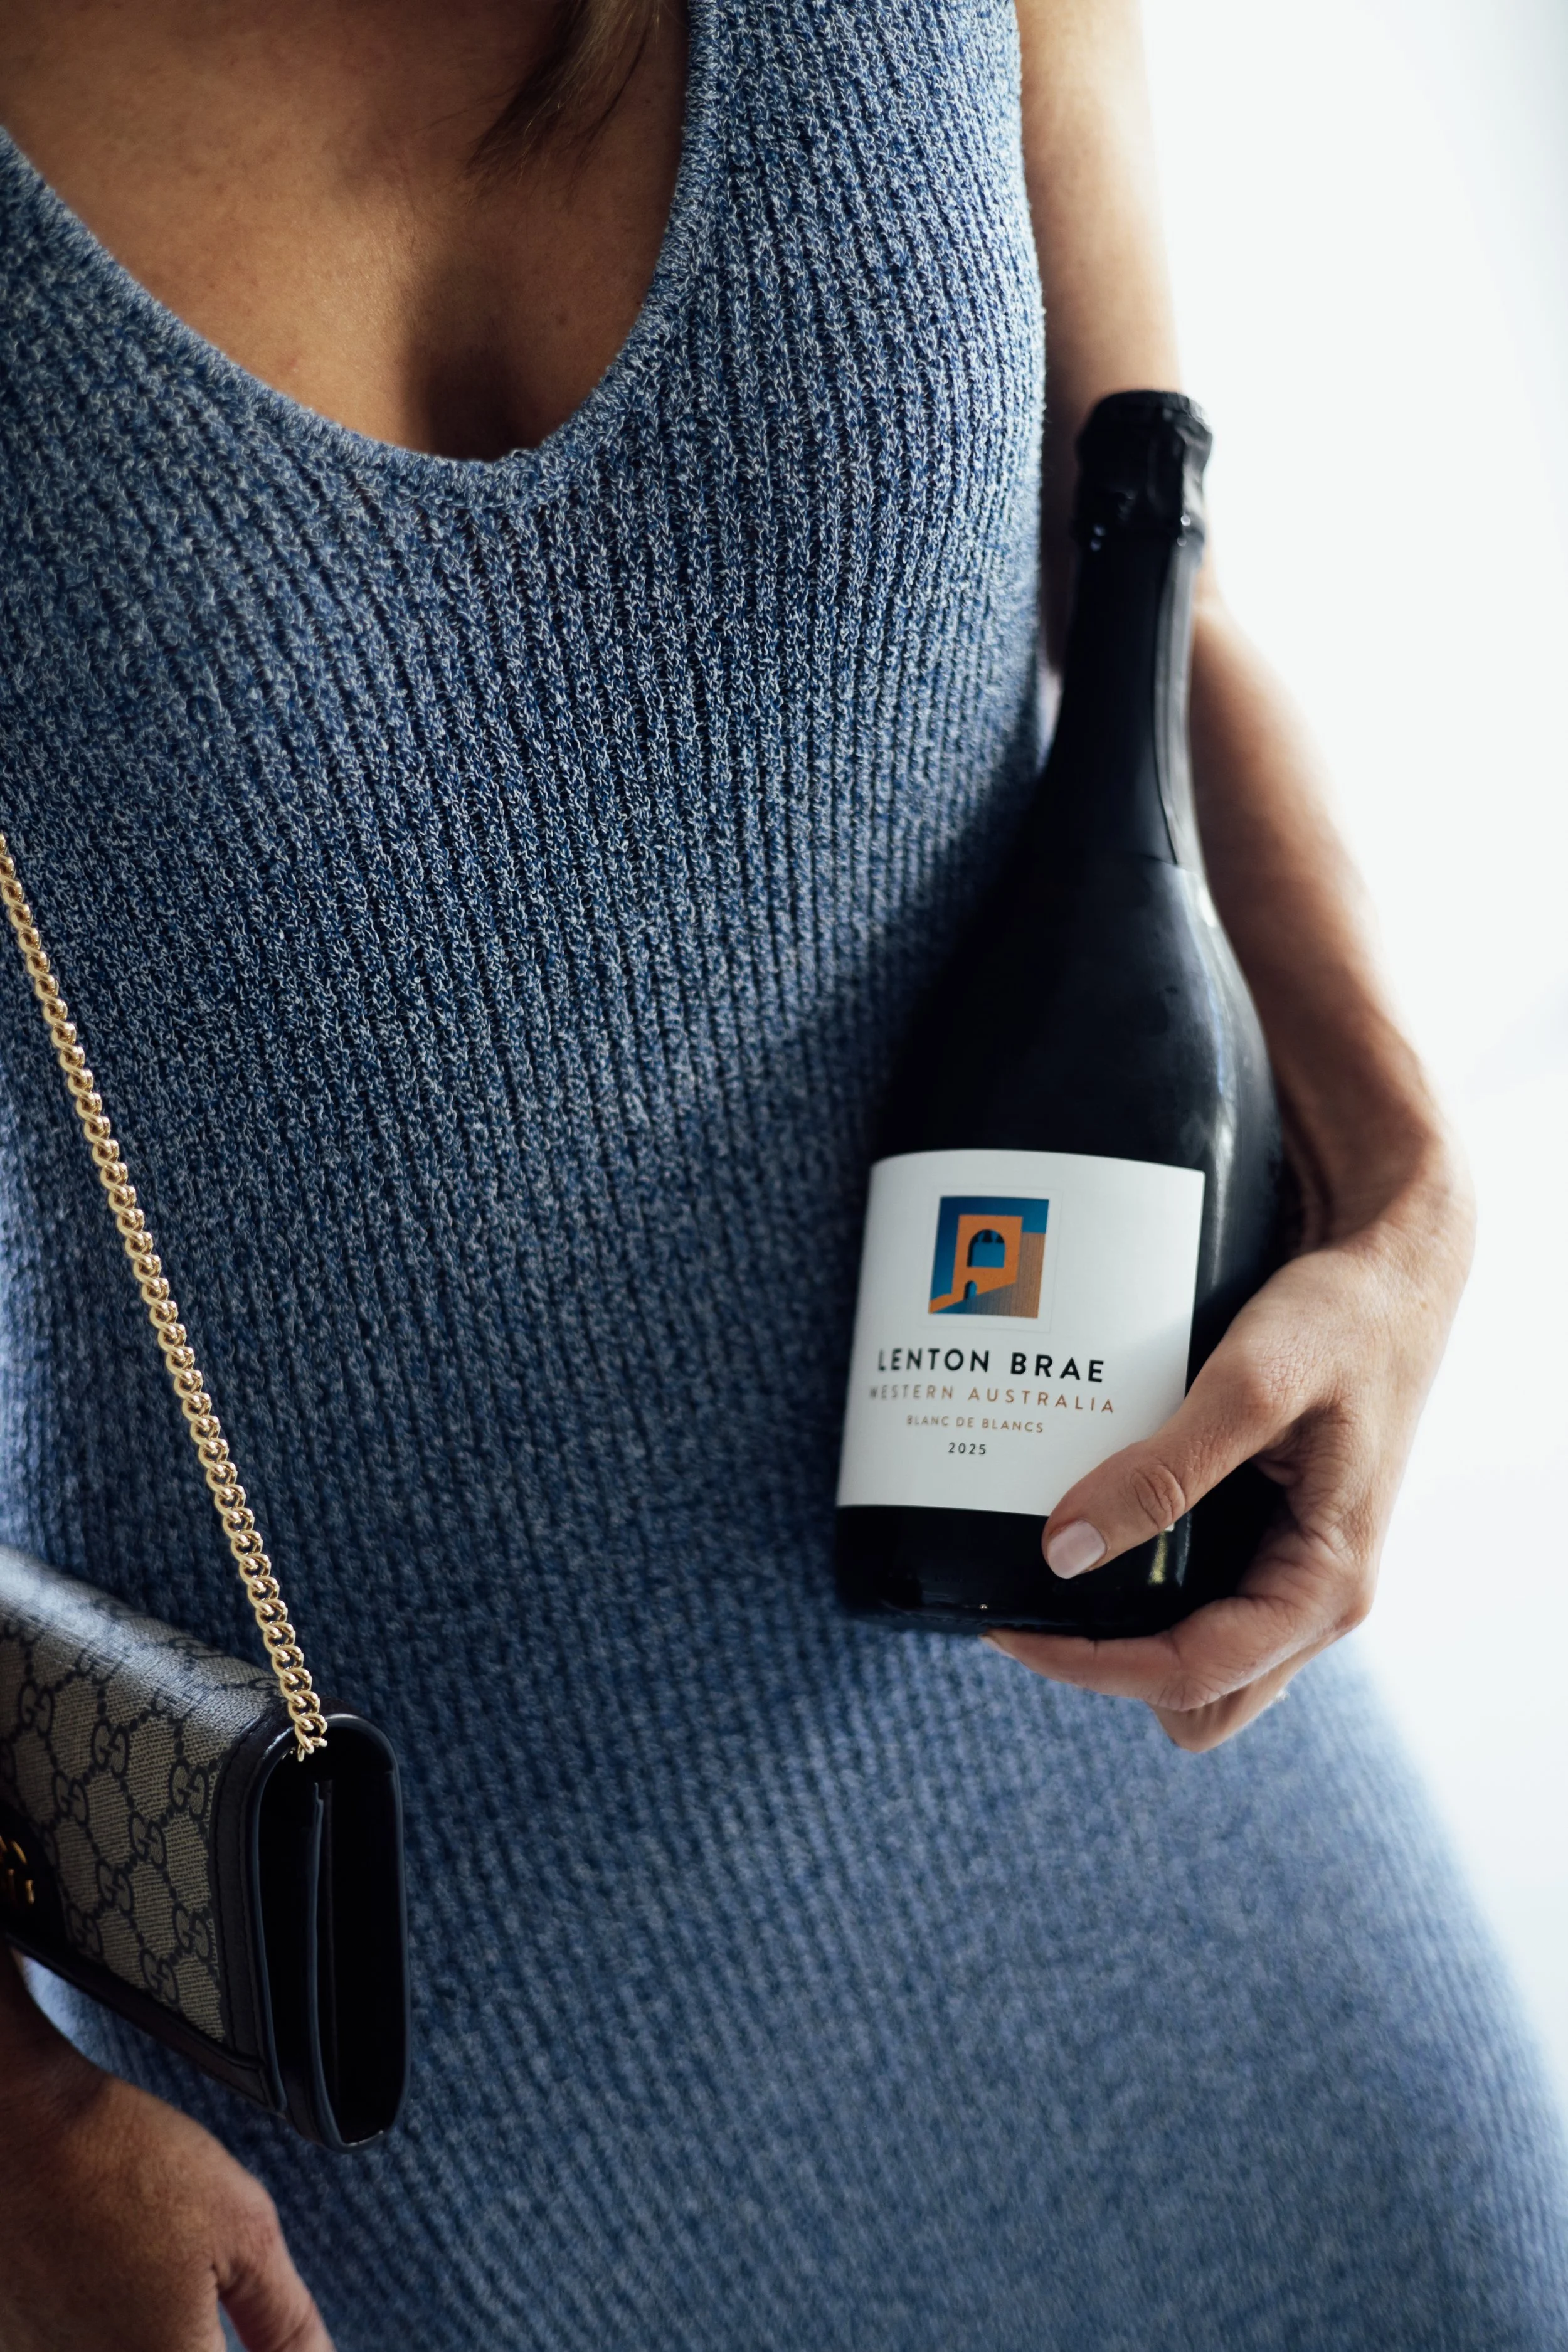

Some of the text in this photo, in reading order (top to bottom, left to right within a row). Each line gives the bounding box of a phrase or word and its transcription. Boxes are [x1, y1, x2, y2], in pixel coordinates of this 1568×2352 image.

[877, 1348, 1104, 1382] LENTON BRAE
[869, 1384, 1114, 1413] WESTERN AUSTRALIA
[907, 1415, 1044, 1433] BLANC DE BLANCS
[948, 1442, 987, 1456] 2025
